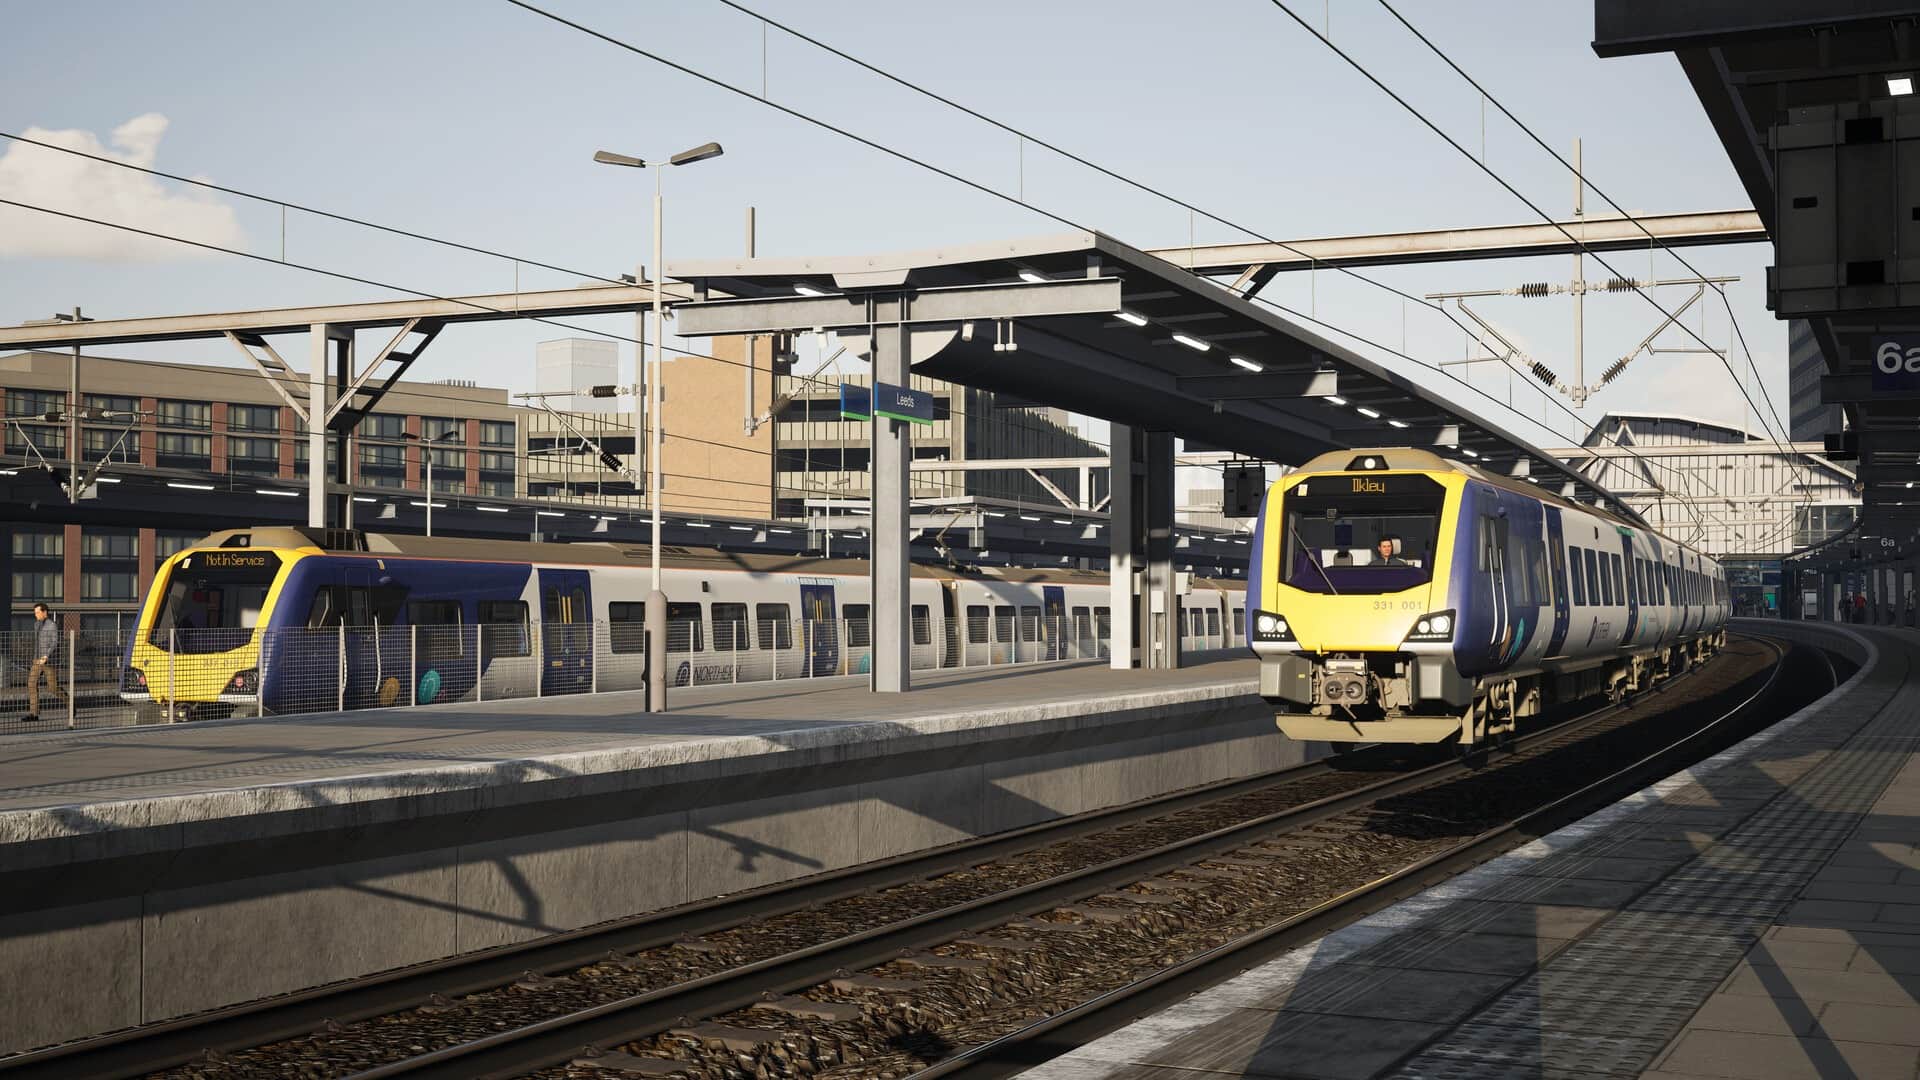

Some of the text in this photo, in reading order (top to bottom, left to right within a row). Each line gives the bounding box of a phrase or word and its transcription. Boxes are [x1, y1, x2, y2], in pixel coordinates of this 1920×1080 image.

[1877, 342, 1920, 373] 6a
[896, 391, 914, 408] Leeds
[1881, 538, 1895, 547] 6a
[206, 554, 265, 566] Not In Service
[1374, 600, 1422, 610] 331 001
